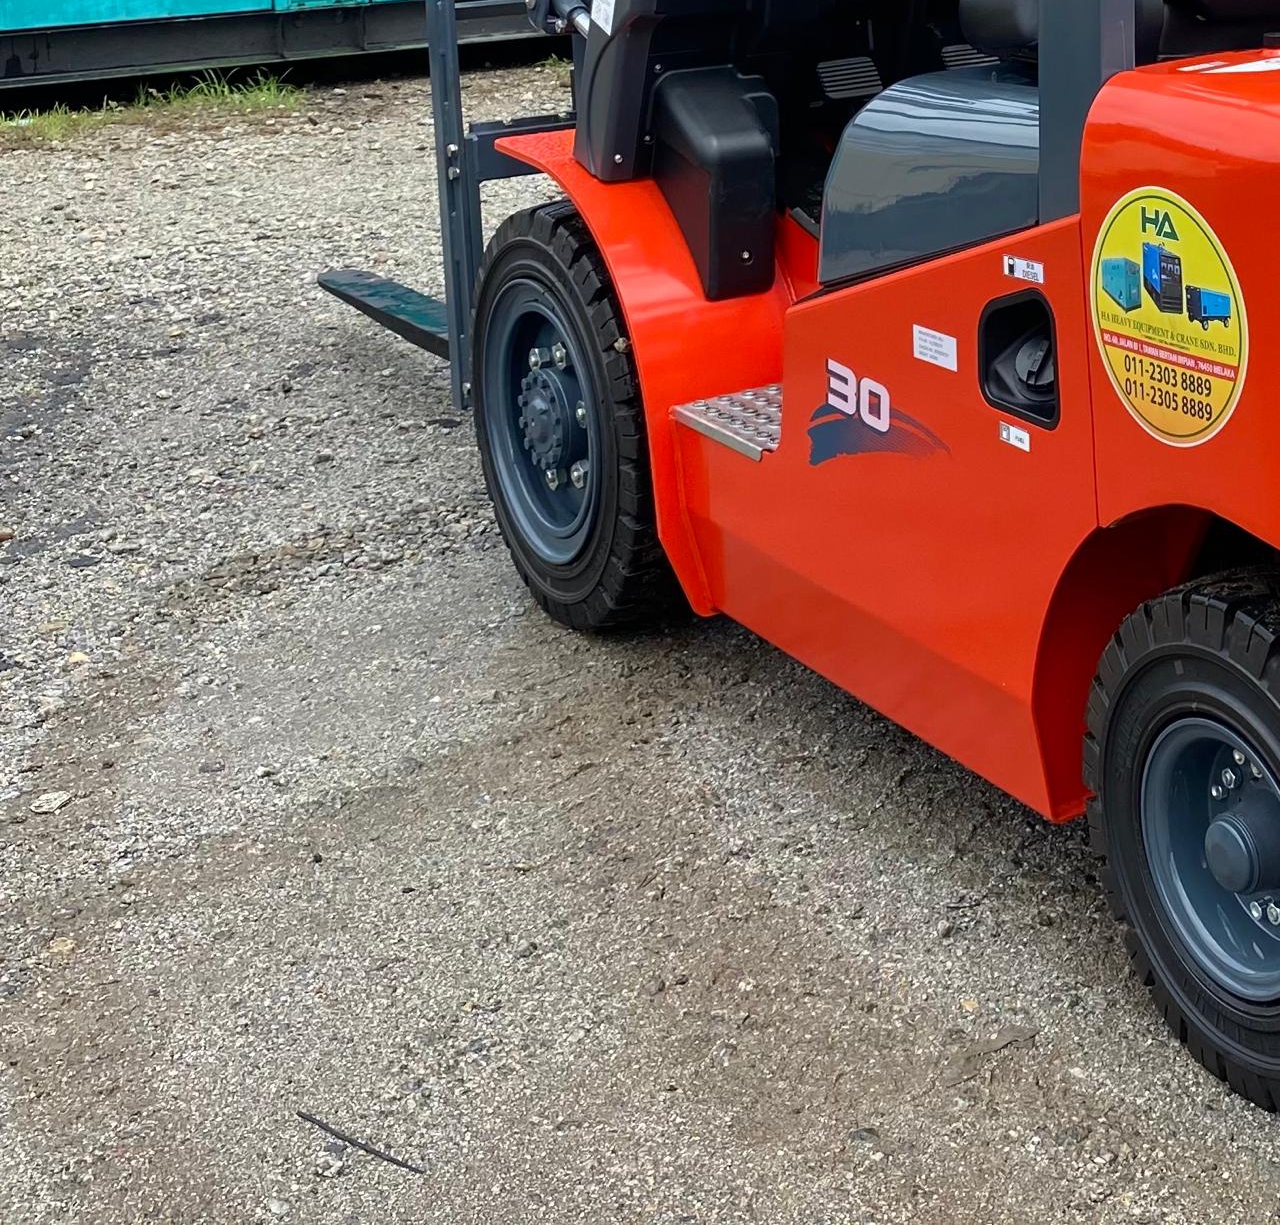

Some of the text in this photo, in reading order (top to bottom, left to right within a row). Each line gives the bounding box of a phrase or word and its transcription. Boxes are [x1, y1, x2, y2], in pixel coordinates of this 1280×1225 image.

[1141, 206, 1179, 241] HA
[1101, 311, 1110, 321] HA
[1111, 314, 1132, 328] HEAVY
[1133, 320, 1168, 339] EQUIPMENT
[1170, 331, 1175, 341] &
[1176, 333, 1199, 347] CRANE
[1200, 339, 1217, 352] SDN.
[1218, 343, 1237, 357] BHD.
[1124, 354, 1212, 397] 011-2303 8889
[1213, 365, 1235, 378] MELAKA
[827, 358, 890, 432] 30
[1125, 378, 1213, 421] 011-2305 8889
